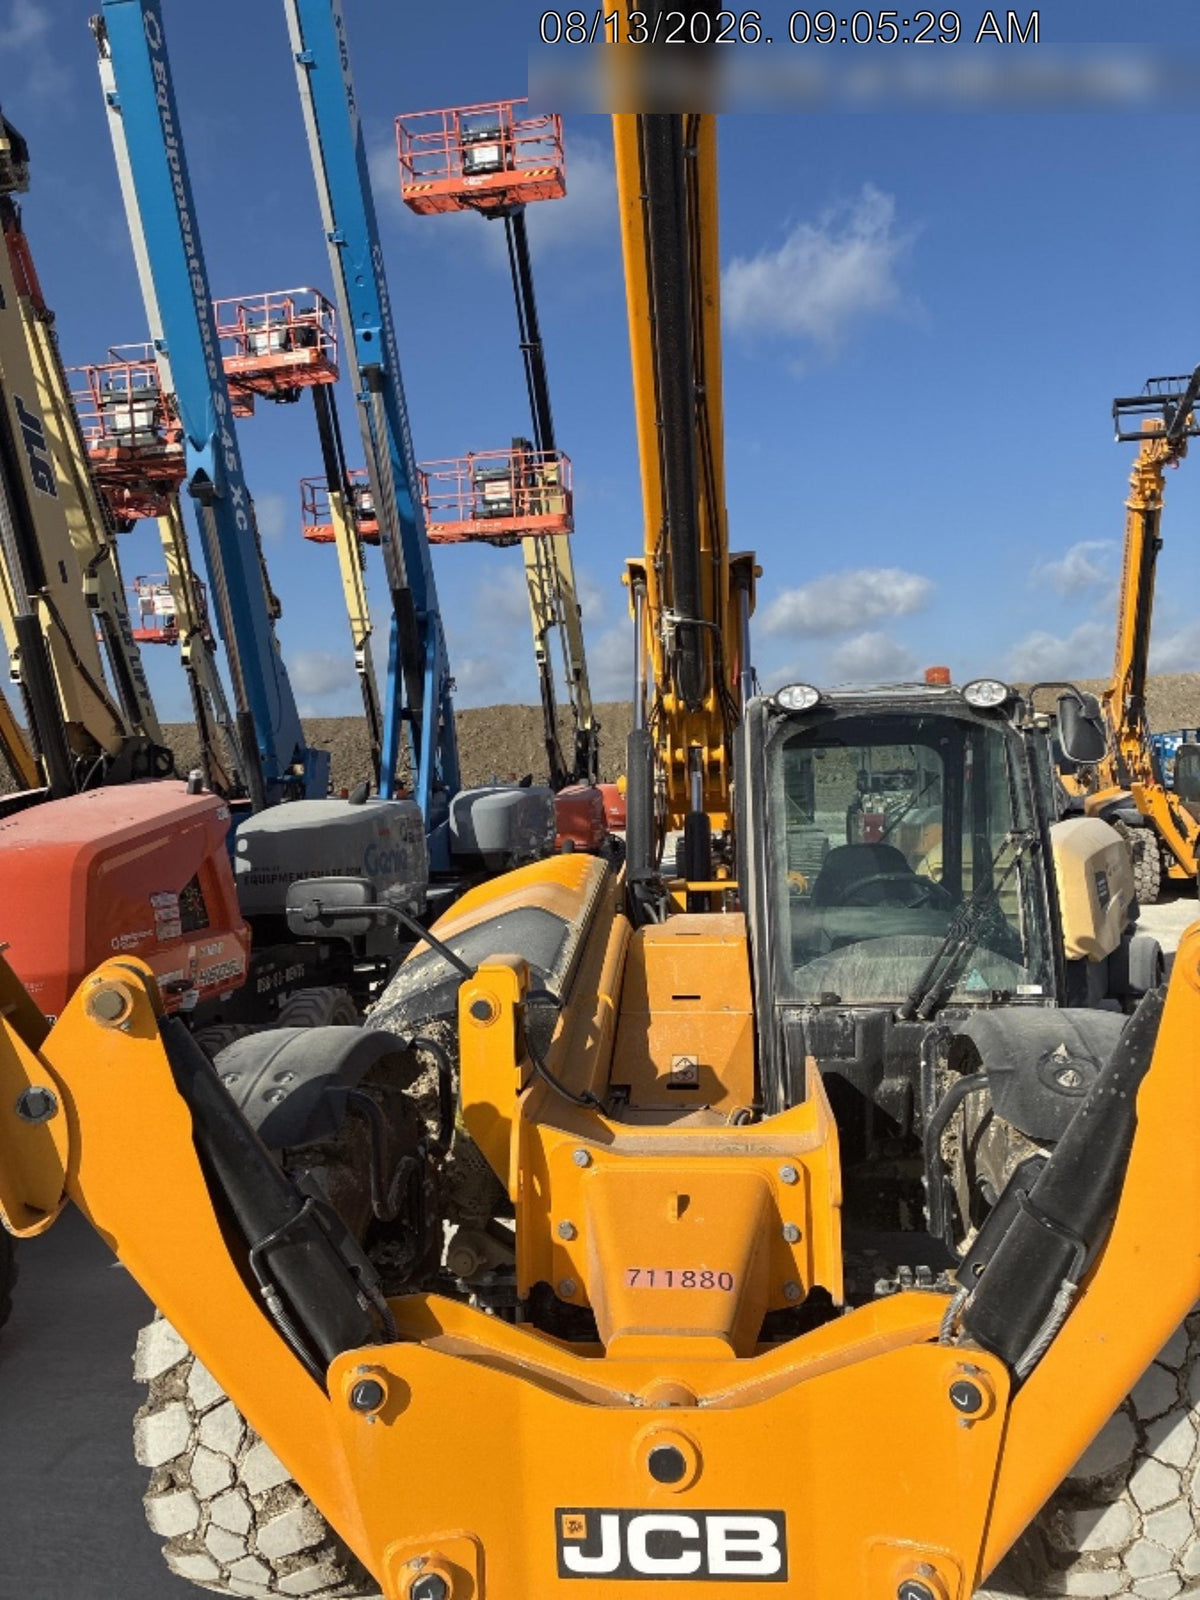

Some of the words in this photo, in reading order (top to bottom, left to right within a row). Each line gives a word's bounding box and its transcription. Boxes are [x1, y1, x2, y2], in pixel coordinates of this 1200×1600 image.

[13, 393, 58, 498] JLG
[213, 390, 239, 472] S-45
[230, 482, 249, 532] XC
[627, 1268, 734, 1291] 711880
[562, 1514, 782, 1575] JCB
